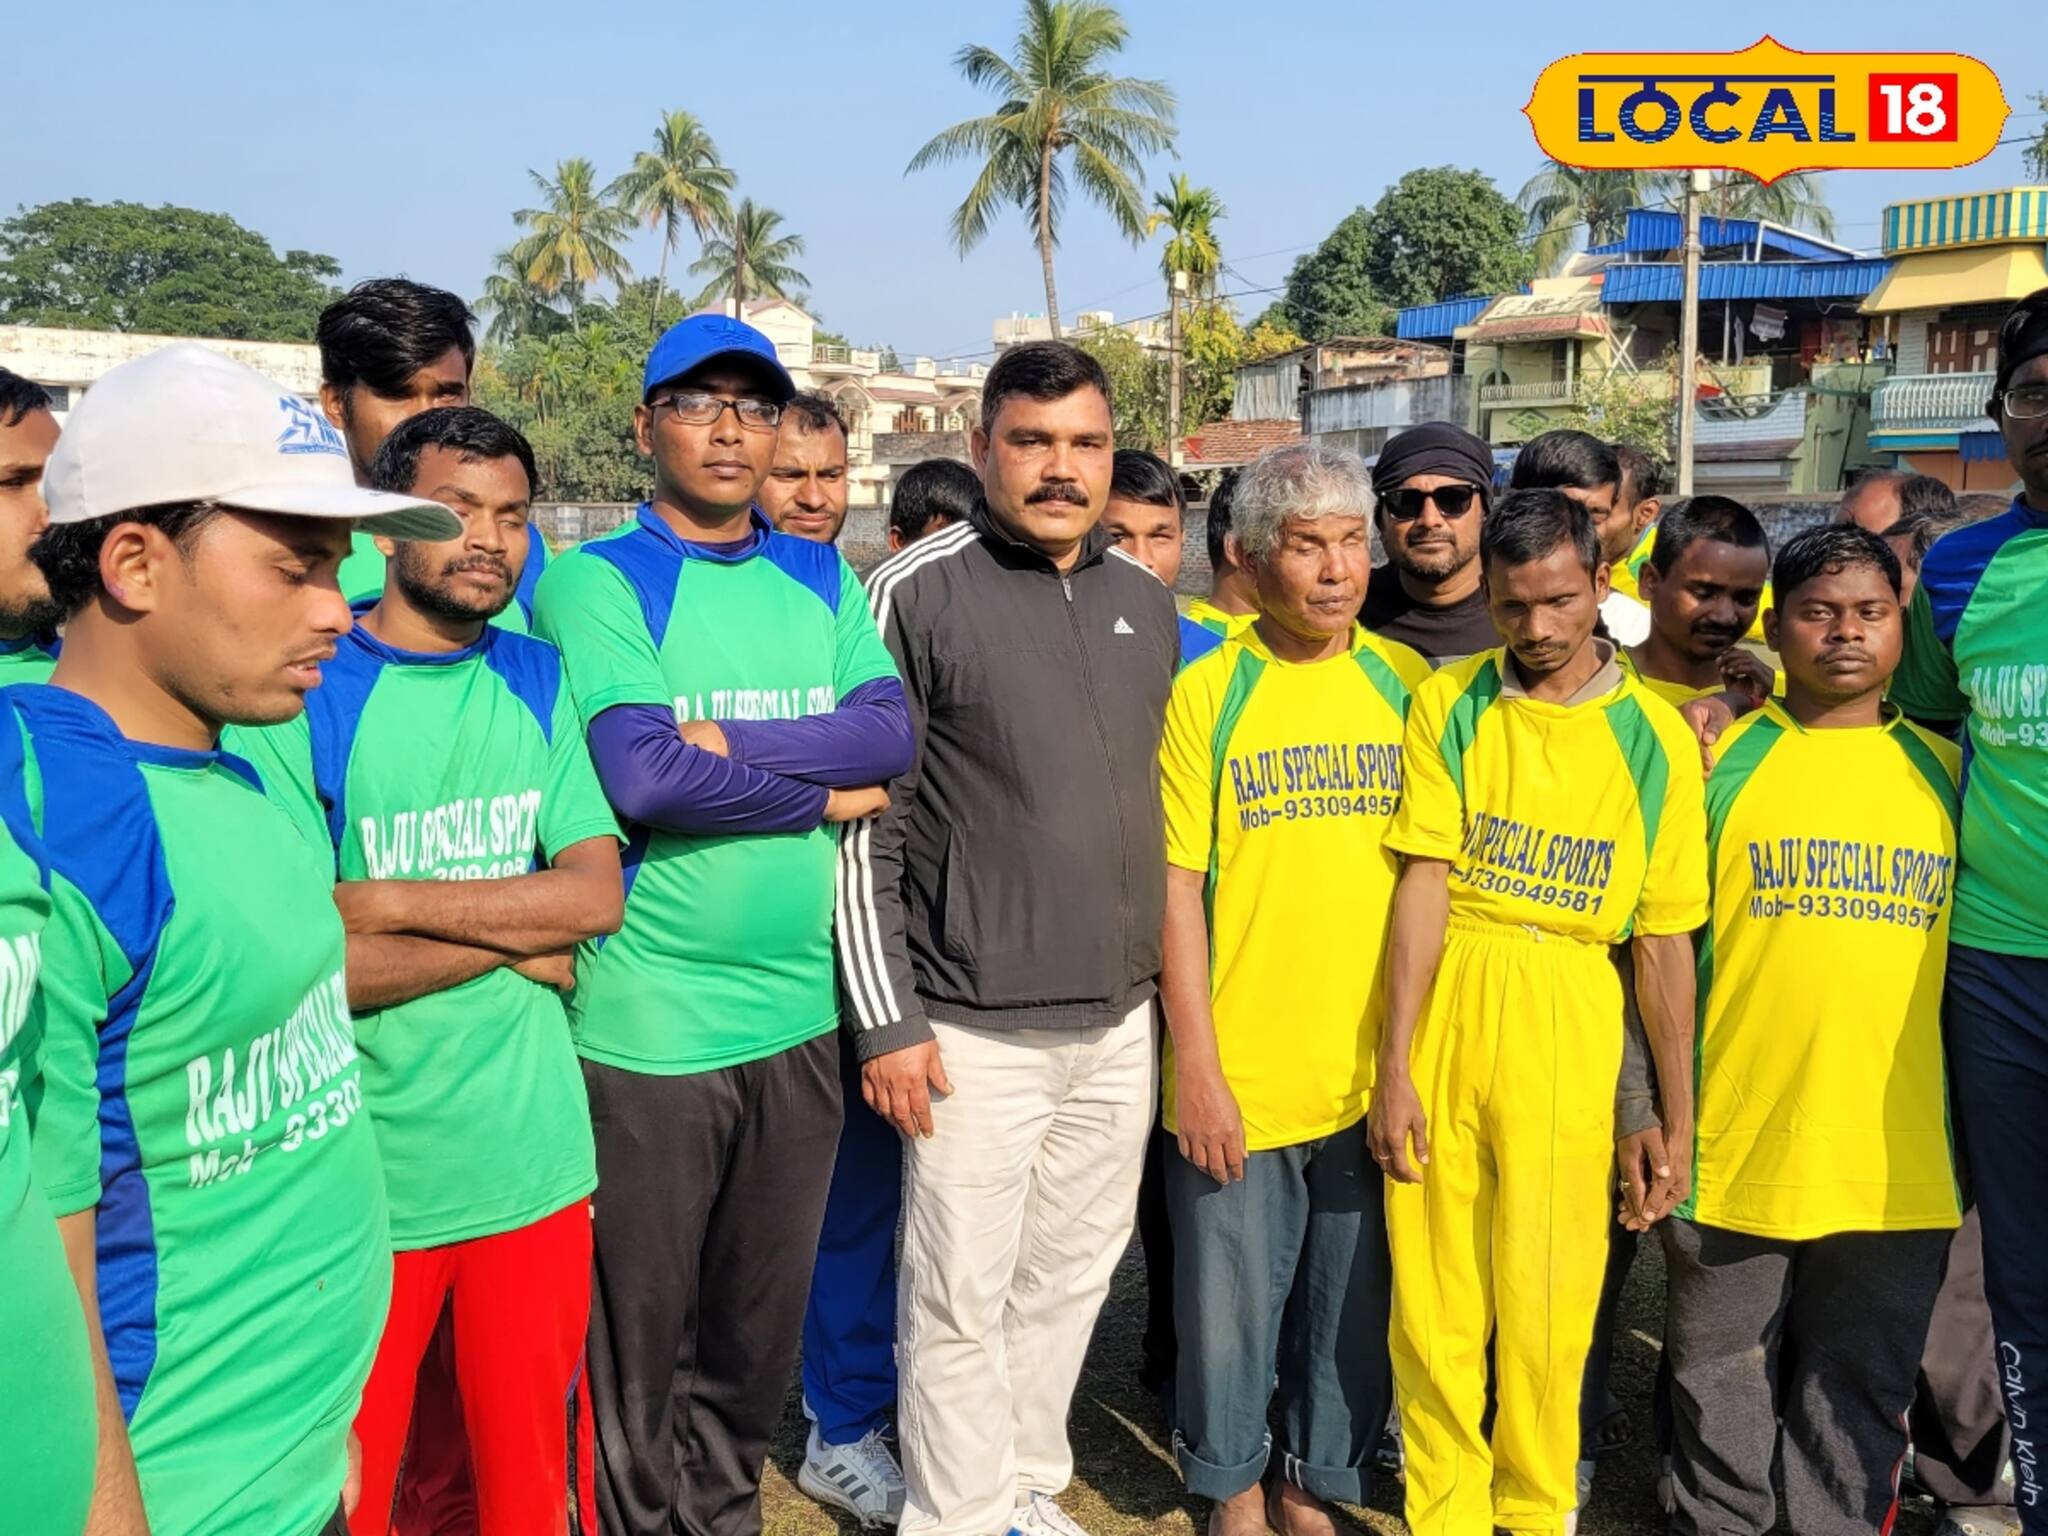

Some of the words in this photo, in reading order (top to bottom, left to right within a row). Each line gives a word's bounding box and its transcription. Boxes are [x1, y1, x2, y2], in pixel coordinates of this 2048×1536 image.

[1230, 750, 1279, 806] RAJU
[1283, 744, 1354, 793] SPECIAL
[1356, 744, 1403, 792] SPOR
[1541, 834, 1615, 890] SPORTS
[1749, 838, 1802, 891] RAJU
[1804, 838, 1886, 895] SPECIAL
[1891, 848, 1952, 908] SPORTS
[185, 1027, 281, 1147] RAJU
[2001, 1341, 2027, 1430] Calvin
[2014, 1436, 2043, 1507] Klein
